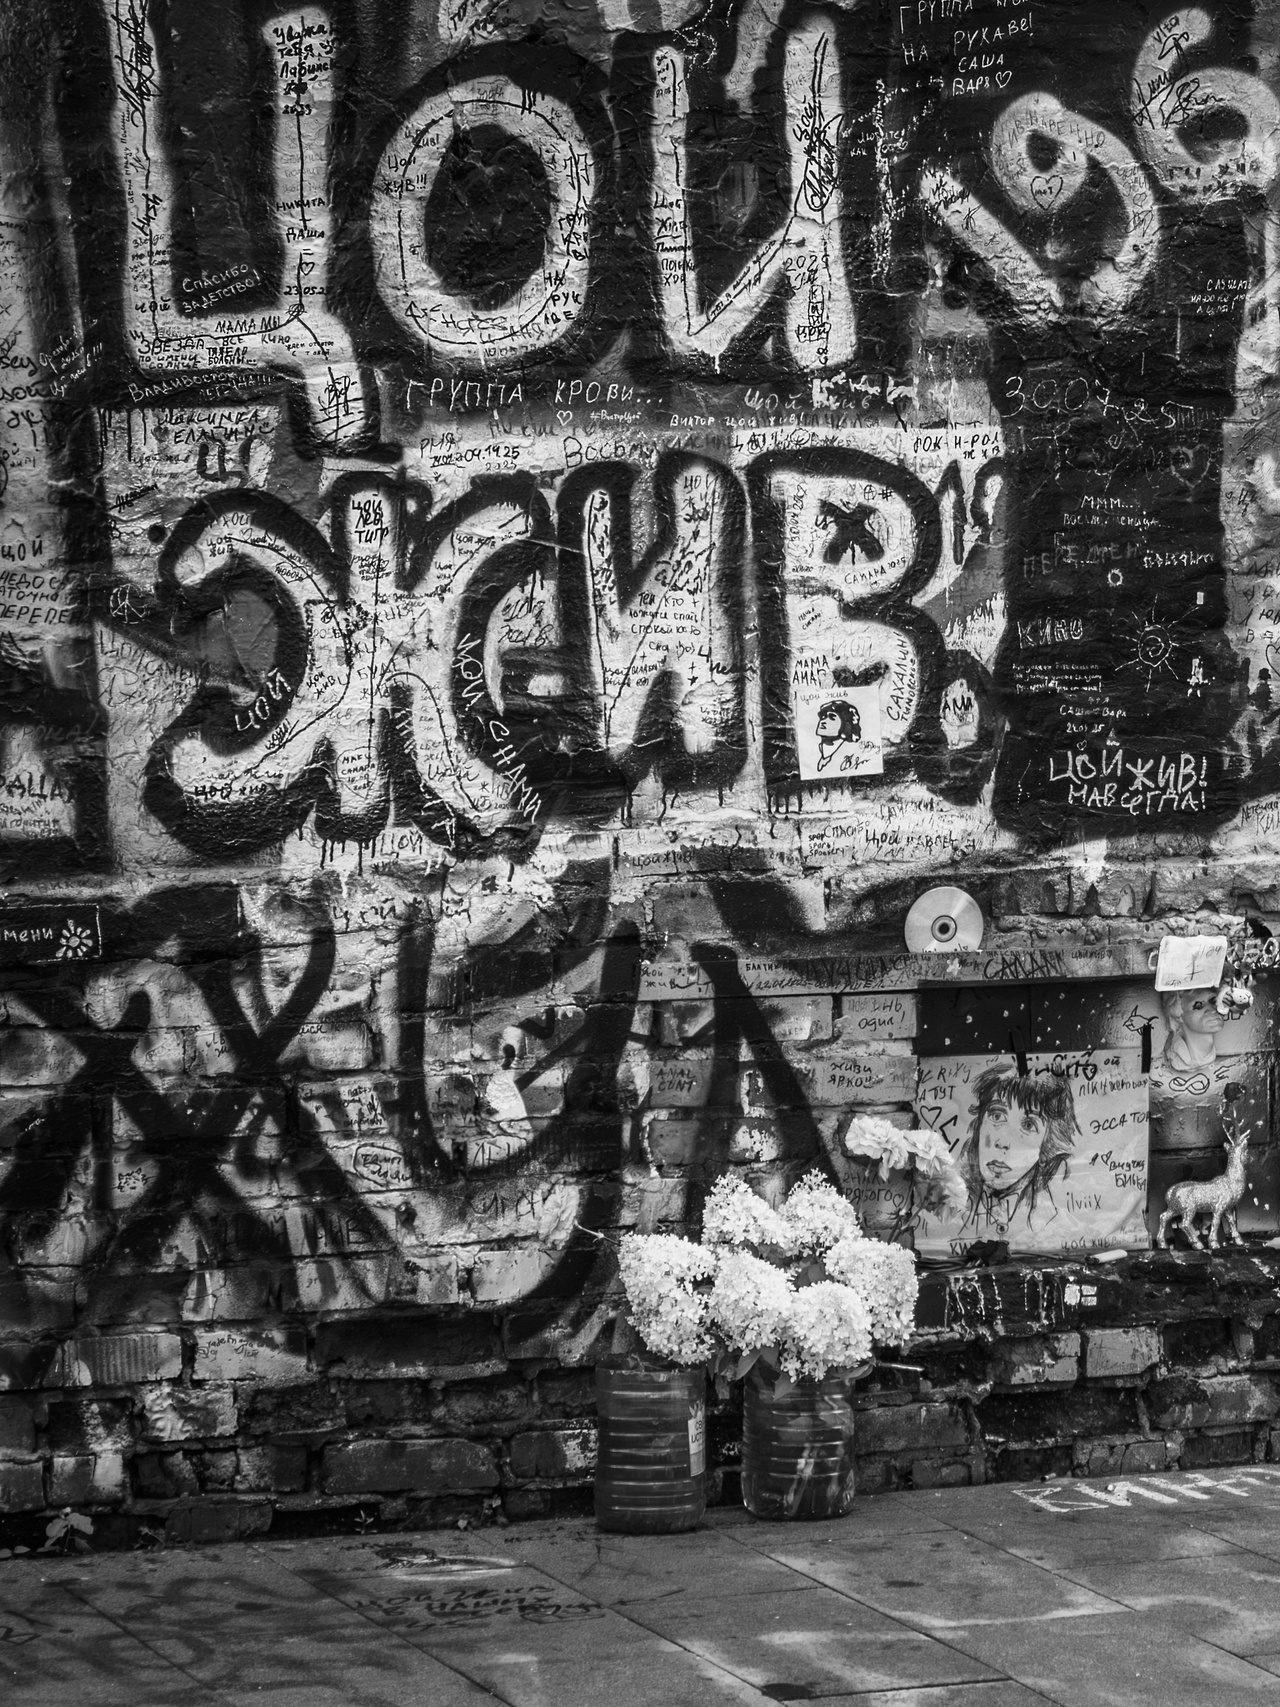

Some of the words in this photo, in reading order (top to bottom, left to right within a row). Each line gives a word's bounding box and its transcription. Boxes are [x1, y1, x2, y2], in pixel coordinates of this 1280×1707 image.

[902, 43, 929, 65] НА
[958, 54, 1004, 73] САША
[276, 198, 326, 212] НИКИТА
[285, 226, 325, 243] ДАША
[406, 378, 524, 411] ГРУППА
[1050, 749, 1124, 784] ЦОЙ
[1126, 753, 1208, 795] ЖИВ!
